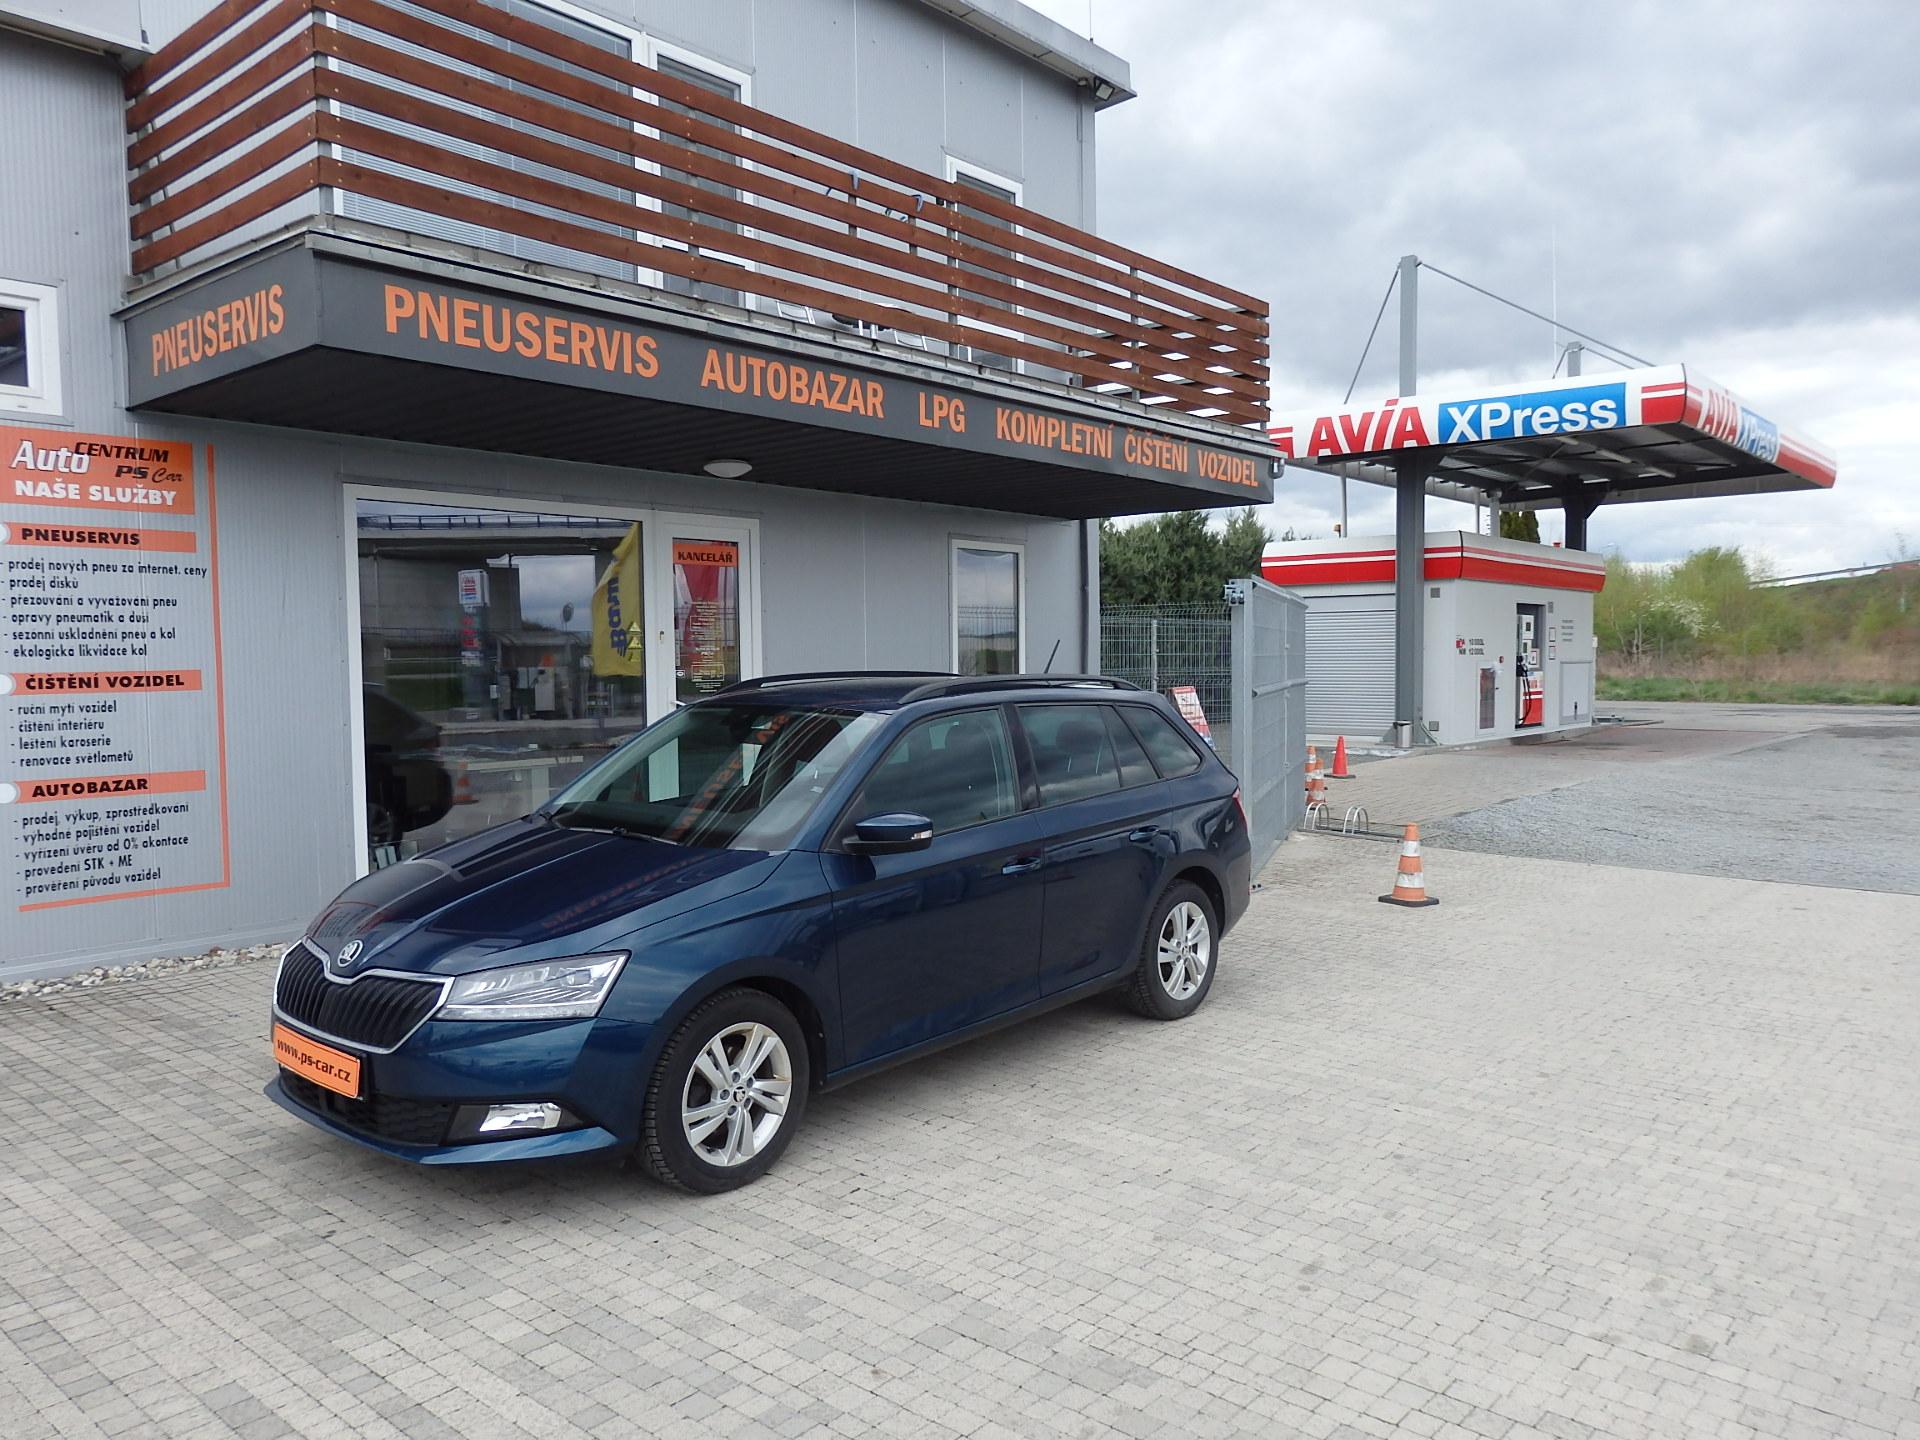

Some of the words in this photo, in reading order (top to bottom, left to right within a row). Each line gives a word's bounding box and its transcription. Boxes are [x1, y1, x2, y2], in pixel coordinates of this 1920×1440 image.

[151, 284, 286, 377] PNEUSERVIS
[384, 284, 661, 379] PNEUSERVIS
[701, 348, 885, 419] AUTOBAZAR
[918, 391, 966, 434] LPG
[996, 407, 1114, 460] KOMPLETNÍ
[1123, 427, 1190, 474] ČIŠTĚNÍ
[1196, 449, 1259, 488] VOZIDEL
[1446, 397, 1618, 444] XPress
[9, 439, 90, 474] Auto
[75, 441, 169, 463] CENTRUM
[115, 465, 149, 480] PS
[152, 467, 184, 484] Car
[15, 477, 80, 500] NAŠE
[89, 484, 177, 506] SLUŽBY
[21, 527, 141, 546] PNEUSERVIS
[678, 551, 733, 563] KANCELÁŘ
[8, 557, 46, 574] prodej
[92, 562, 118, 575] pneu
[121, 564, 134, 573] za
[184, 567, 208, 579] ceny
[9, 575, 46, 591] prodej
[77, 597, 84, 606] a
[152, 598, 177, 610] pneu
[11, 613, 52, 626] opravy
[56, 610, 114, 626] pneumatik
[118, 614, 125, 623] a
[121, 631, 147, 642] pneu
[150, 631, 156, 639] a
[160, 626, 176, 640] kol
[79, 643, 127, 657] likvidace
[131, 643, 147, 657] kol
[25, 673, 99, 690] ČIŠTĚNÍ
[106, 675, 185, 688] VOZIDEL
[79, 700, 117, 713] vozidel
[60, 734, 111, 748] karoserie
[20, 755, 71, 767] renovace
[32, 778, 149, 798] AUTOBAZAR
[123, 819, 160, 833] vozidel
[107, 839, 120, 852] od
[123, 837, 138, 850] 0%
[142, 836, 189, 849] akontace
[84, 857, 105, 871] STK
[118, 854, 133, 868] ME
[125, 867, 161, 883] vozidel
[277, 1038, 352, 1083] www.ps-car.cz
